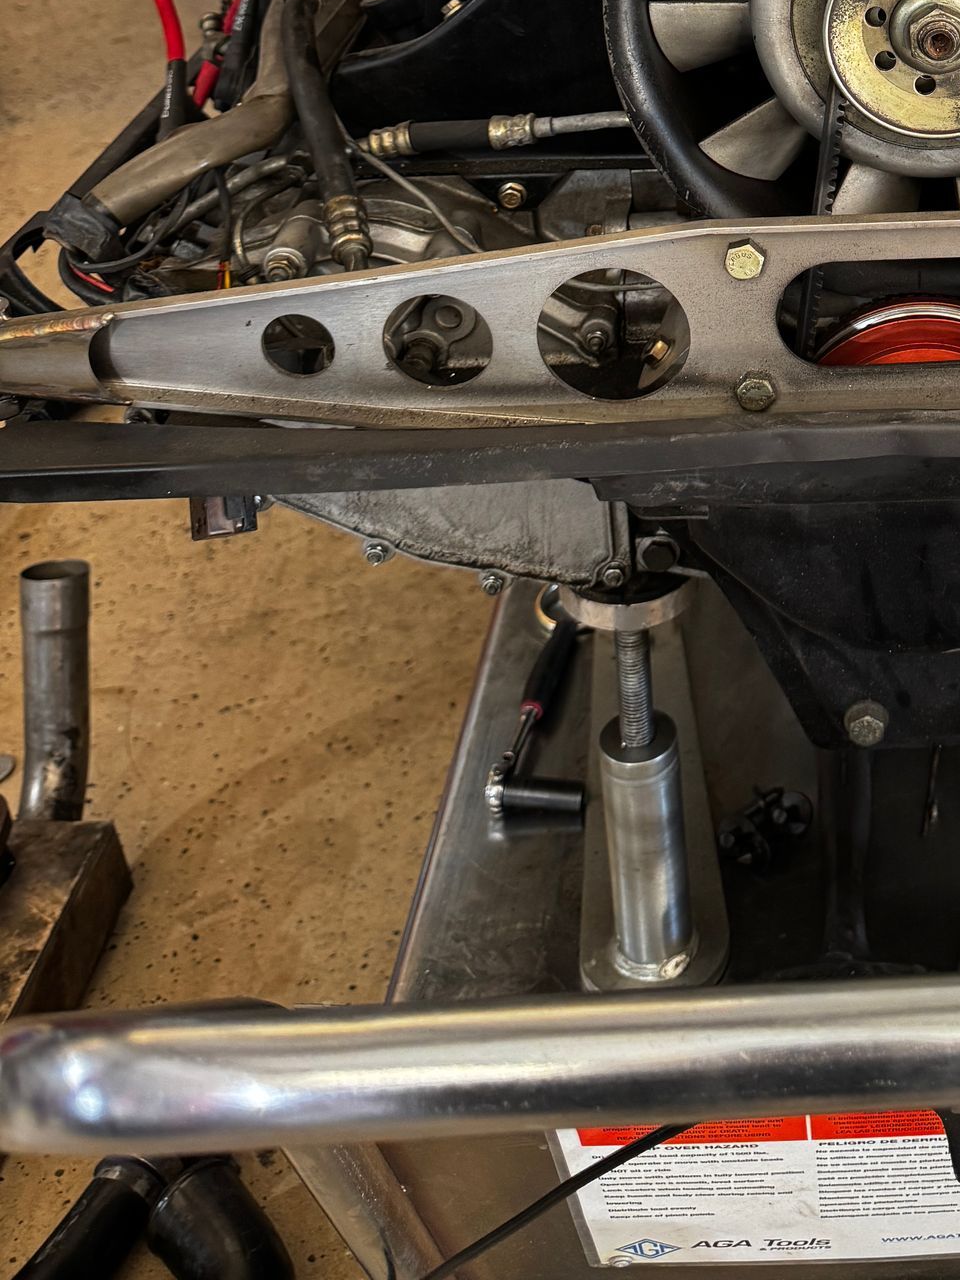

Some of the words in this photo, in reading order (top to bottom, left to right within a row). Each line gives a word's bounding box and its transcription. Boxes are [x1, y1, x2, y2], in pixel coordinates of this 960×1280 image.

[704, 1142, 759, 1151] HAZARD
[818, 1138, 876, 1147] PELIGRO
[902, 1136, 948, 1145] DERRU
[690, 1239, 752, 1249] AGA
[763, 1237, 831, 1248] Tools
